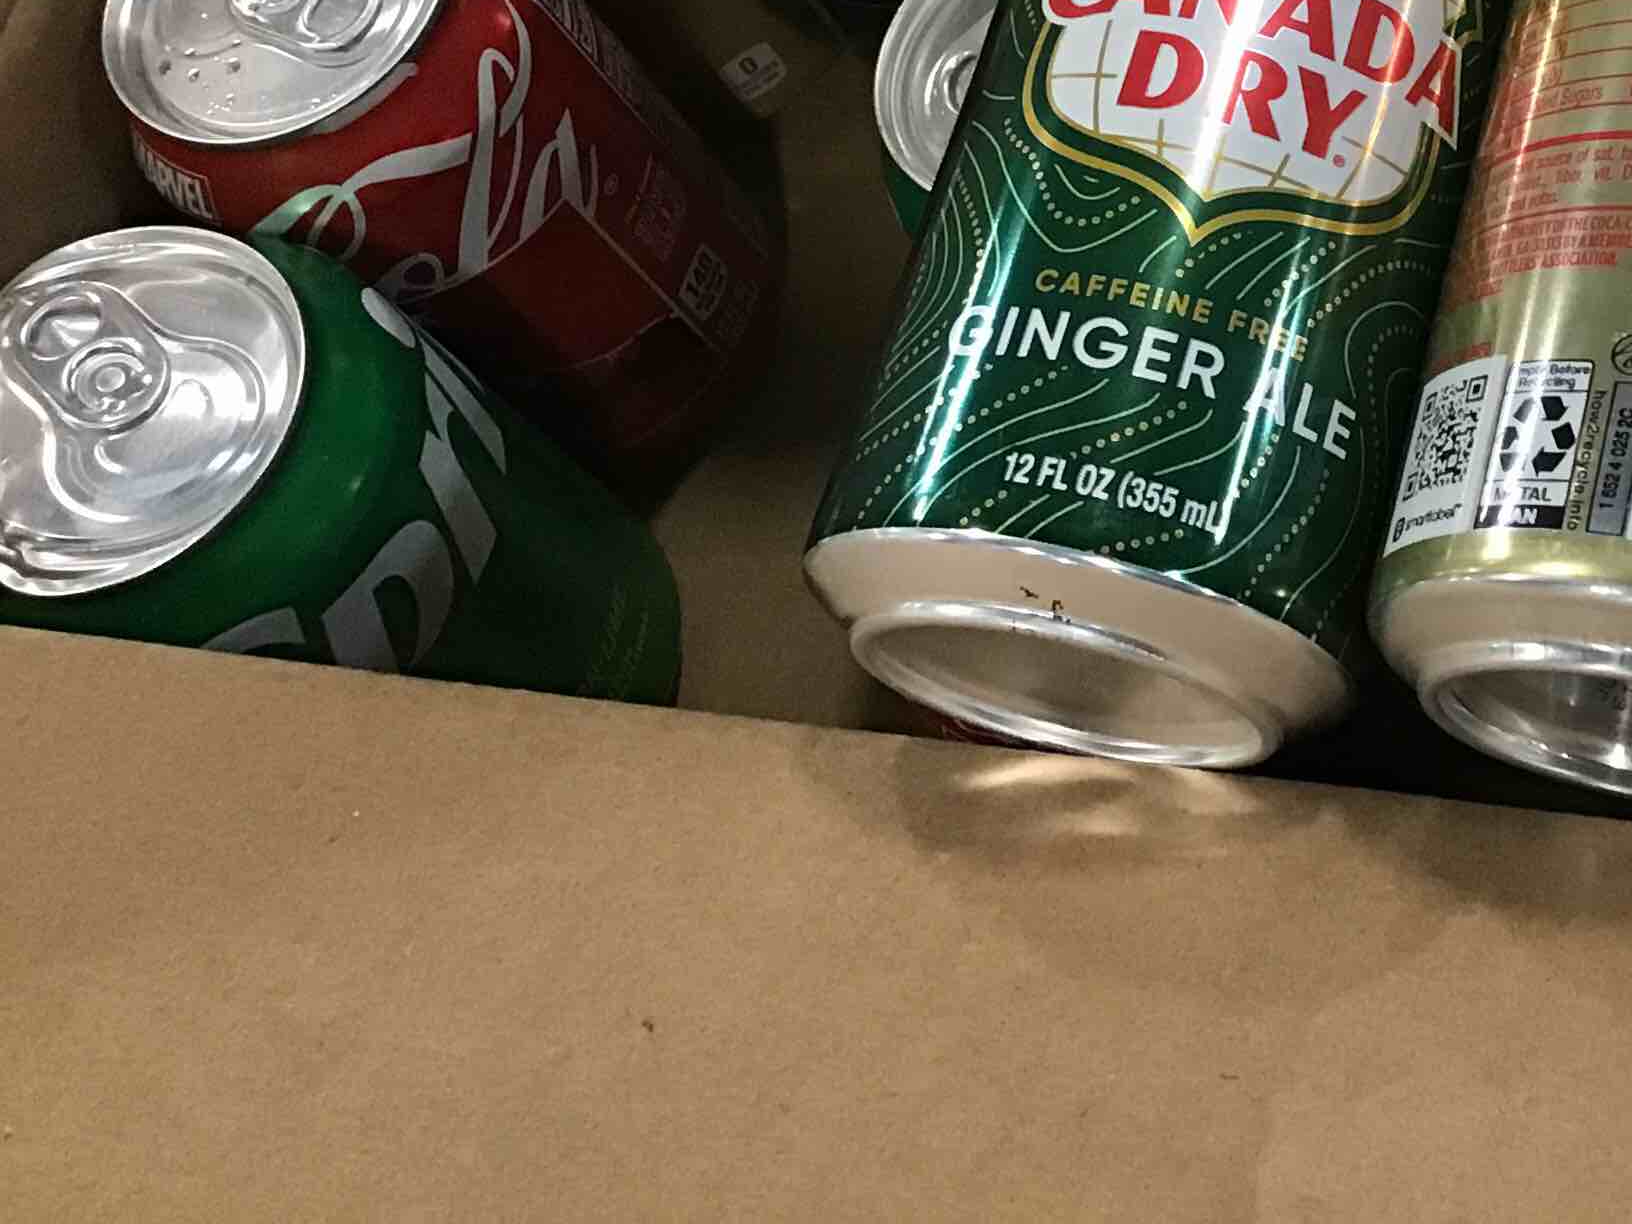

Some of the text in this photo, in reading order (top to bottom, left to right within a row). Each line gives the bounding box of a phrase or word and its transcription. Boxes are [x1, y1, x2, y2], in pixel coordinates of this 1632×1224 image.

[1116, 28, 1368, 160] DRY
[1034, 268, 1309, 363] CAFFEINE FREE
[1550, 363, 1591, 376] Before
[947, 304, 1357, 461] GINGER ALE
[1003, 452, 1031, 484] 12
[1036, 454, 1069, 490] FL
[1076, 465, 1114, 501] OZ
[1118, 469, 1177, 515] (355
[1567, 388, 1608, 531] how2recycle.info
